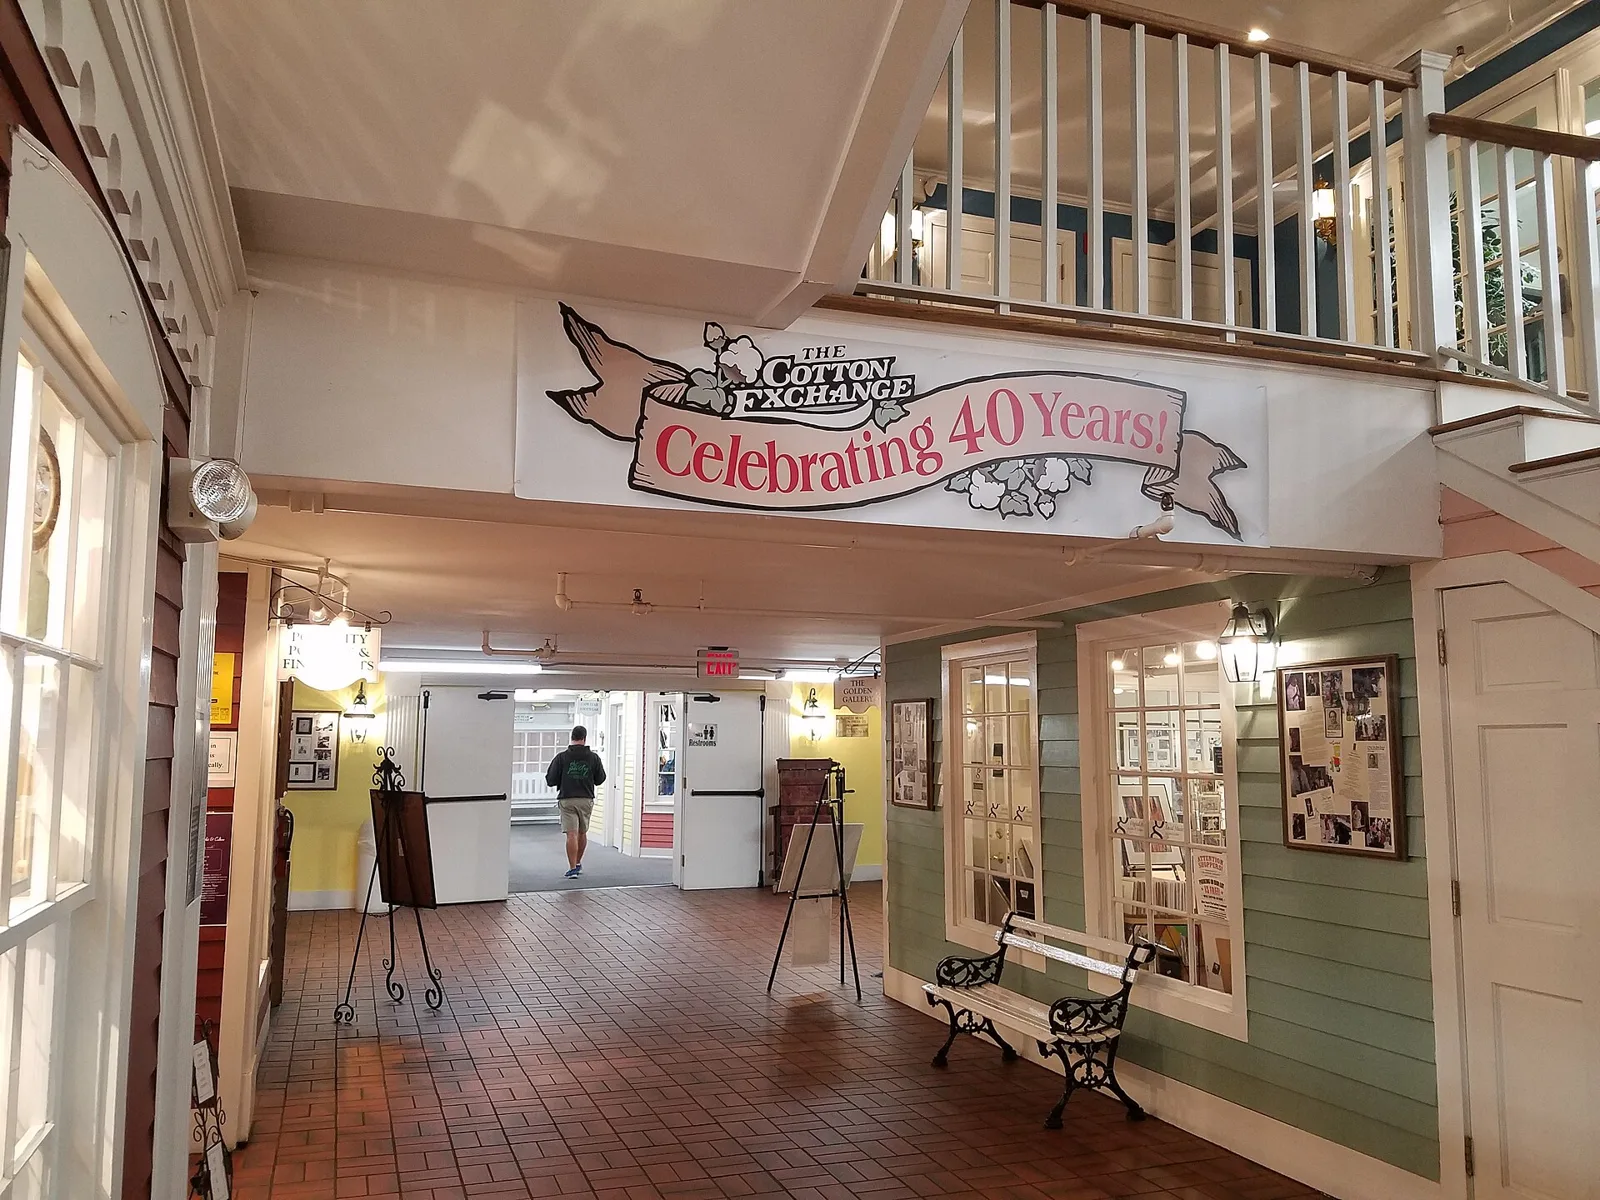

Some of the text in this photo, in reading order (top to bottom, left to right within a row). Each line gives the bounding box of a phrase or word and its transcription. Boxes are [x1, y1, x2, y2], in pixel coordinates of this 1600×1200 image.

[802, 345, 846, 360] THE
[763, 357, 890, 387] COTTON
[733, 377, 913, 411] EXCHANGE
[655, 388, 1168, 494] Celebrating 40 Years!
[359, 647, 370, 658] &
[706, 653, 737, 676] EXIT
[843, 687, 872, 695] GOLDEN
[842, 695, 873, 703] GALLERY
[689, 739, 717, 747] Restrooms
[1198, 855, 1224, 866] ATTENTION
